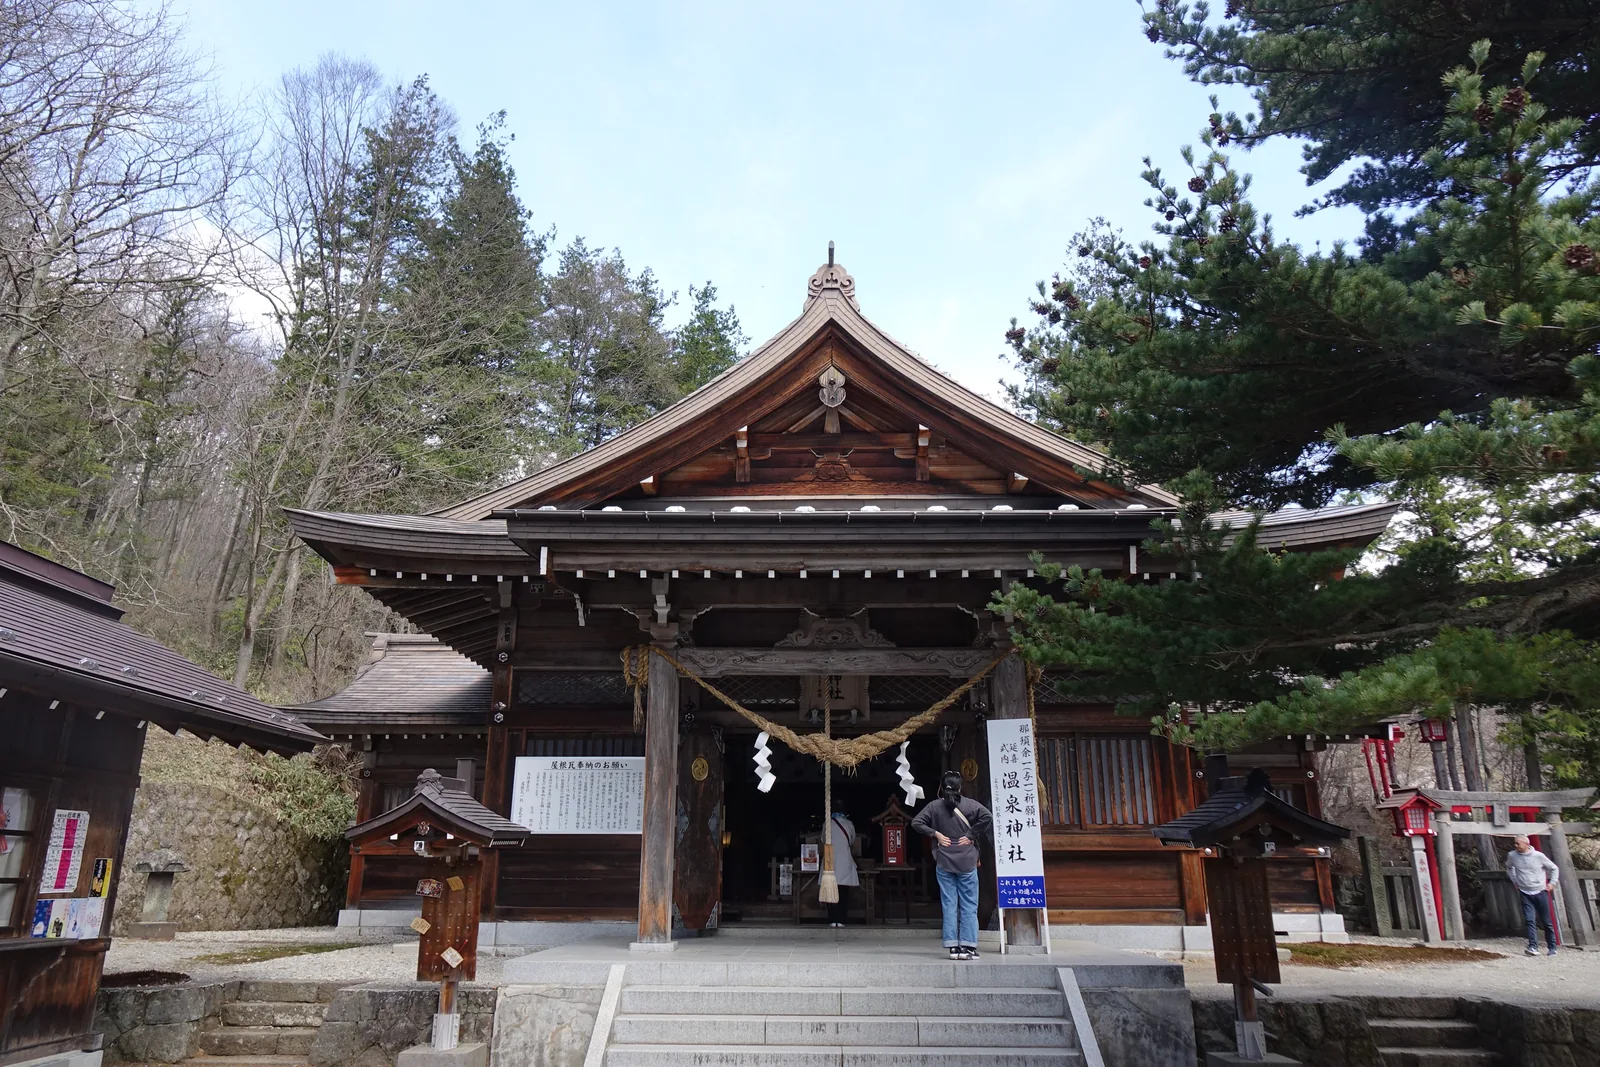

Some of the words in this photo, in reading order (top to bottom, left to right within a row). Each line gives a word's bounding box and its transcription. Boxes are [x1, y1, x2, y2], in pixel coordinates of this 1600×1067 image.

[1000, 743, 1009, 764] 式内
[1009, 742, 1019, 764] 延喜
[551, 760, 628, 770] 屋根瓦奉納のお願い
[1002, 771, 1027, 864] 温泉神社
[999, 878, 1034, 887] これより先の
[1000, 887, 1043, 896] ペットの進入は
[1006, 896, 1043, 905] ご遠慮下さい
